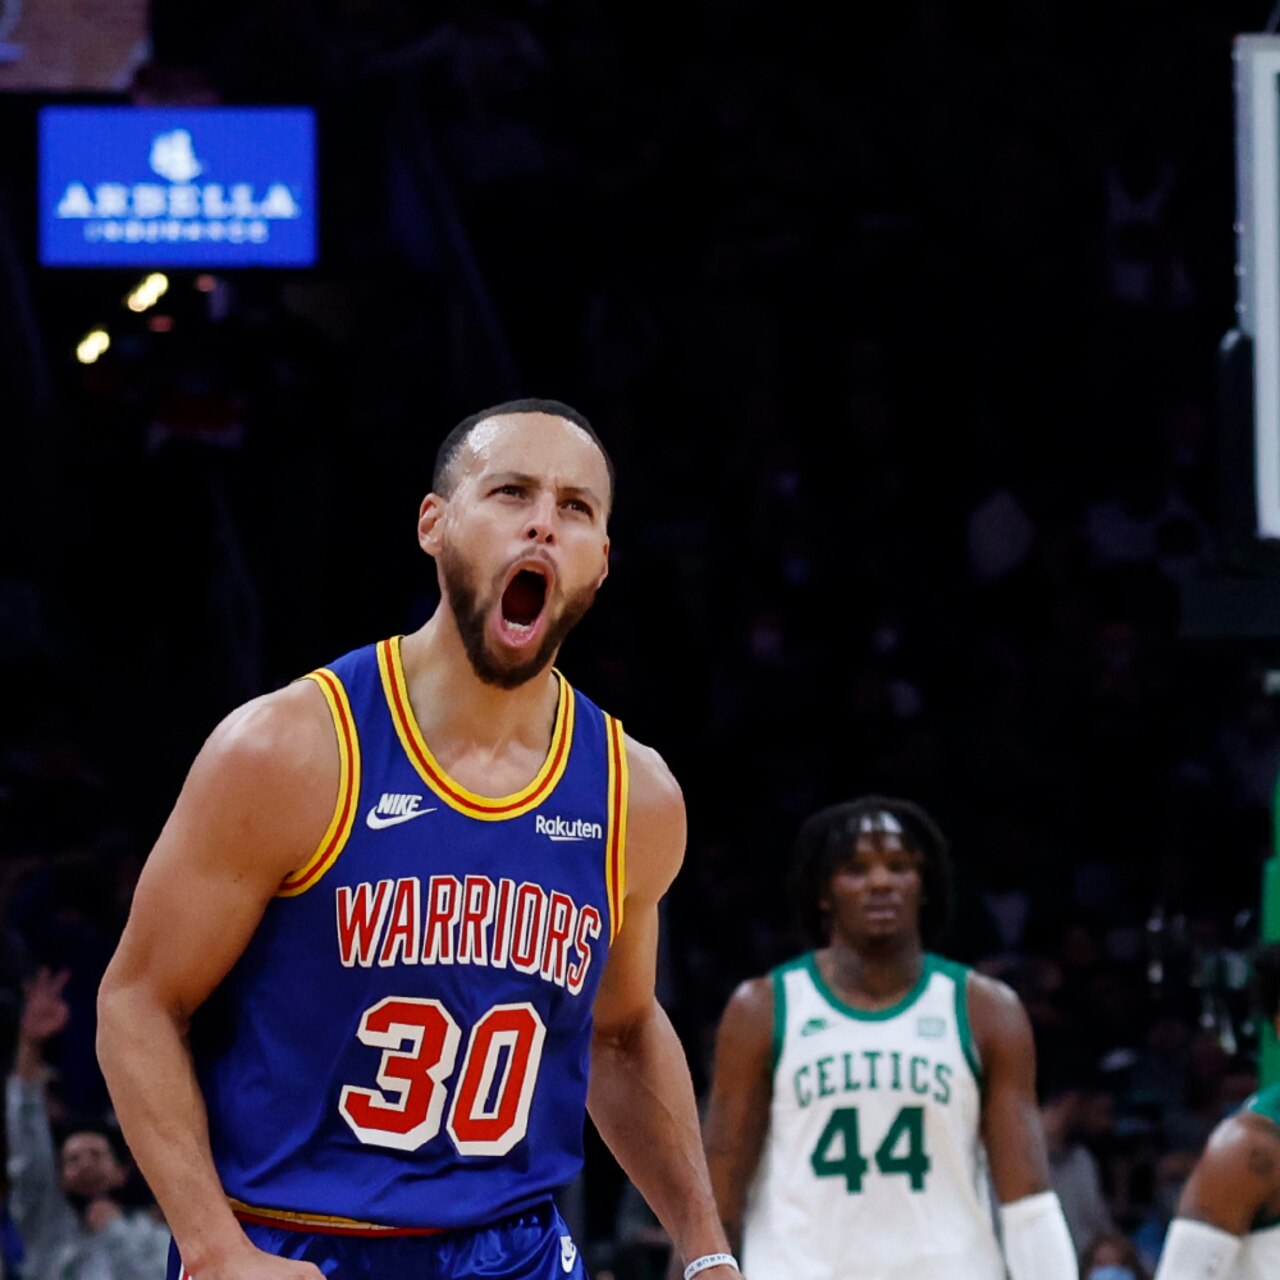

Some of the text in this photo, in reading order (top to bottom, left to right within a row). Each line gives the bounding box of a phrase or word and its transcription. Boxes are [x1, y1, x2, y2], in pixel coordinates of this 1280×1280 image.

[376, 793, 423, 815] NIKE
[535, 814, 603, 840] Rakuten
[336, 874, 603, 996] WARRIORS
[338, 996, 547, 1156] 30
[793, 1051, 953, 1109] CELTICS
[810, 1106, 931, 1195] 44
